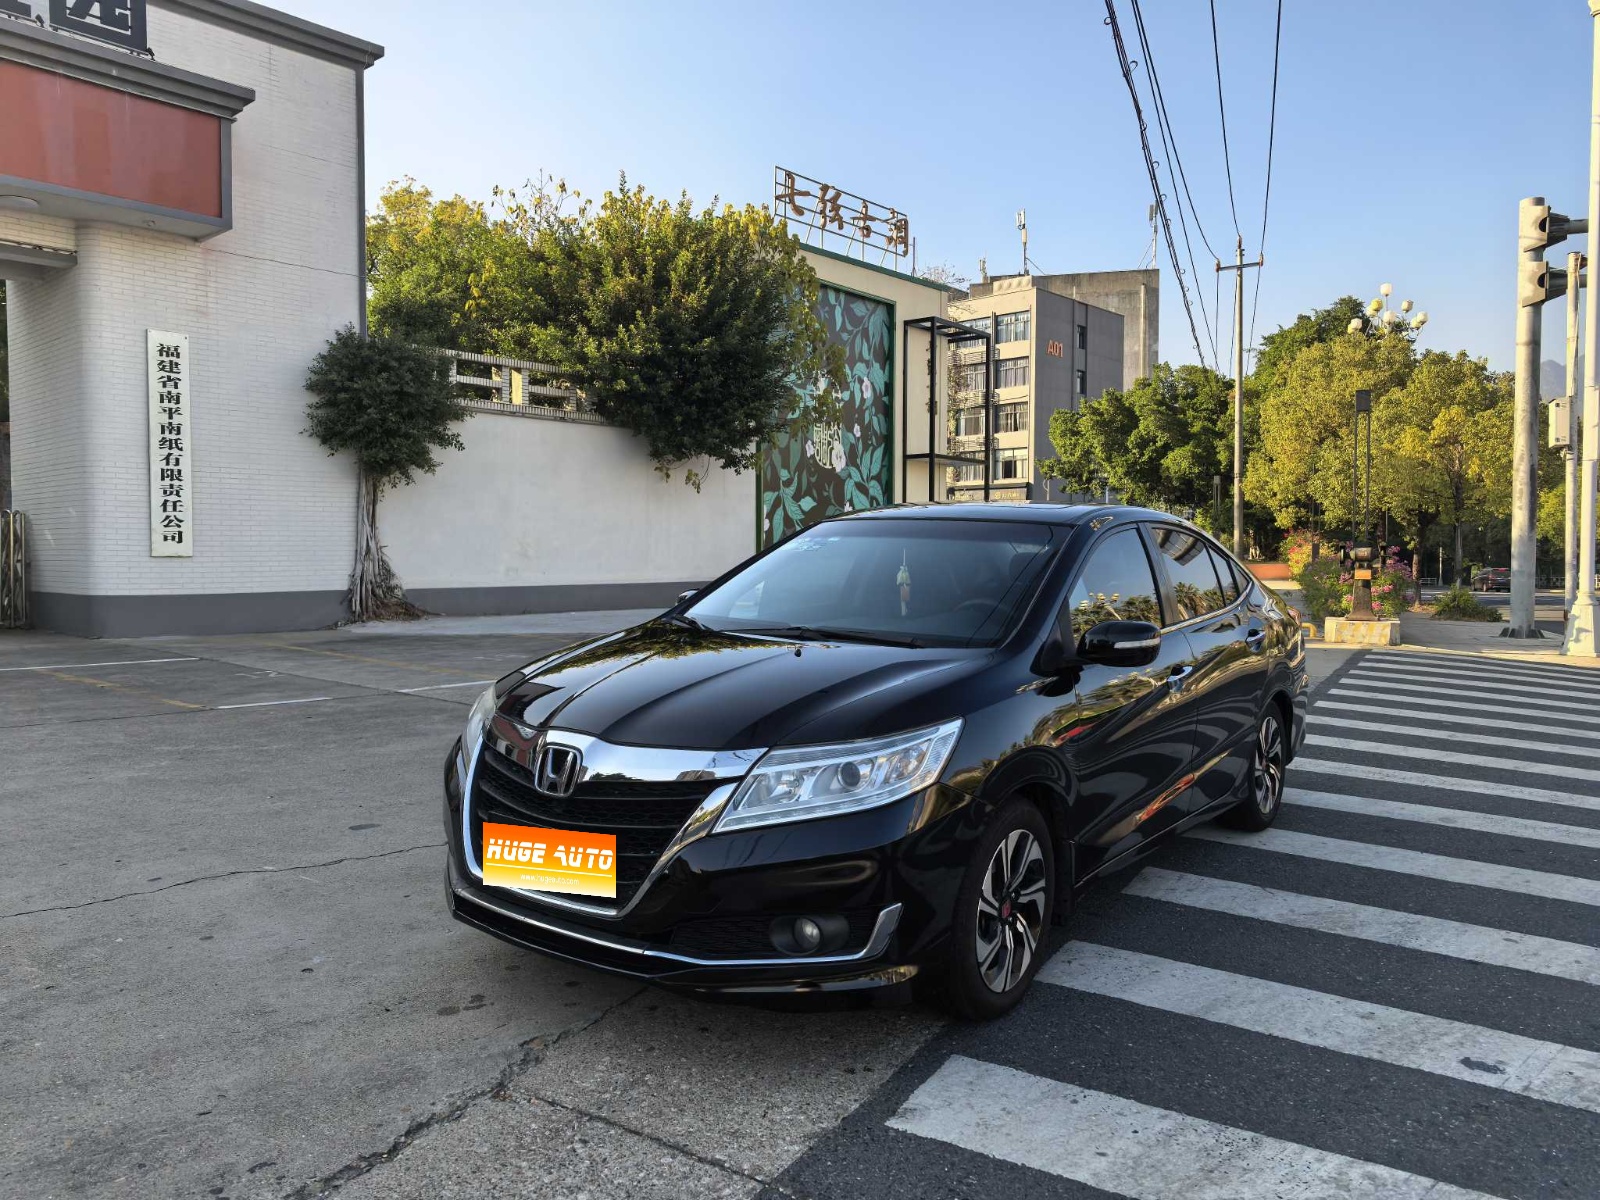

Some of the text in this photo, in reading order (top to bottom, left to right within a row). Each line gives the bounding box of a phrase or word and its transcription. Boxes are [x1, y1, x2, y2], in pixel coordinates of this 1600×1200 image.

[1046, 339, 1063, 358] A01
[156, 342, 185, 545] 福建省南平南纸有限责任公司
